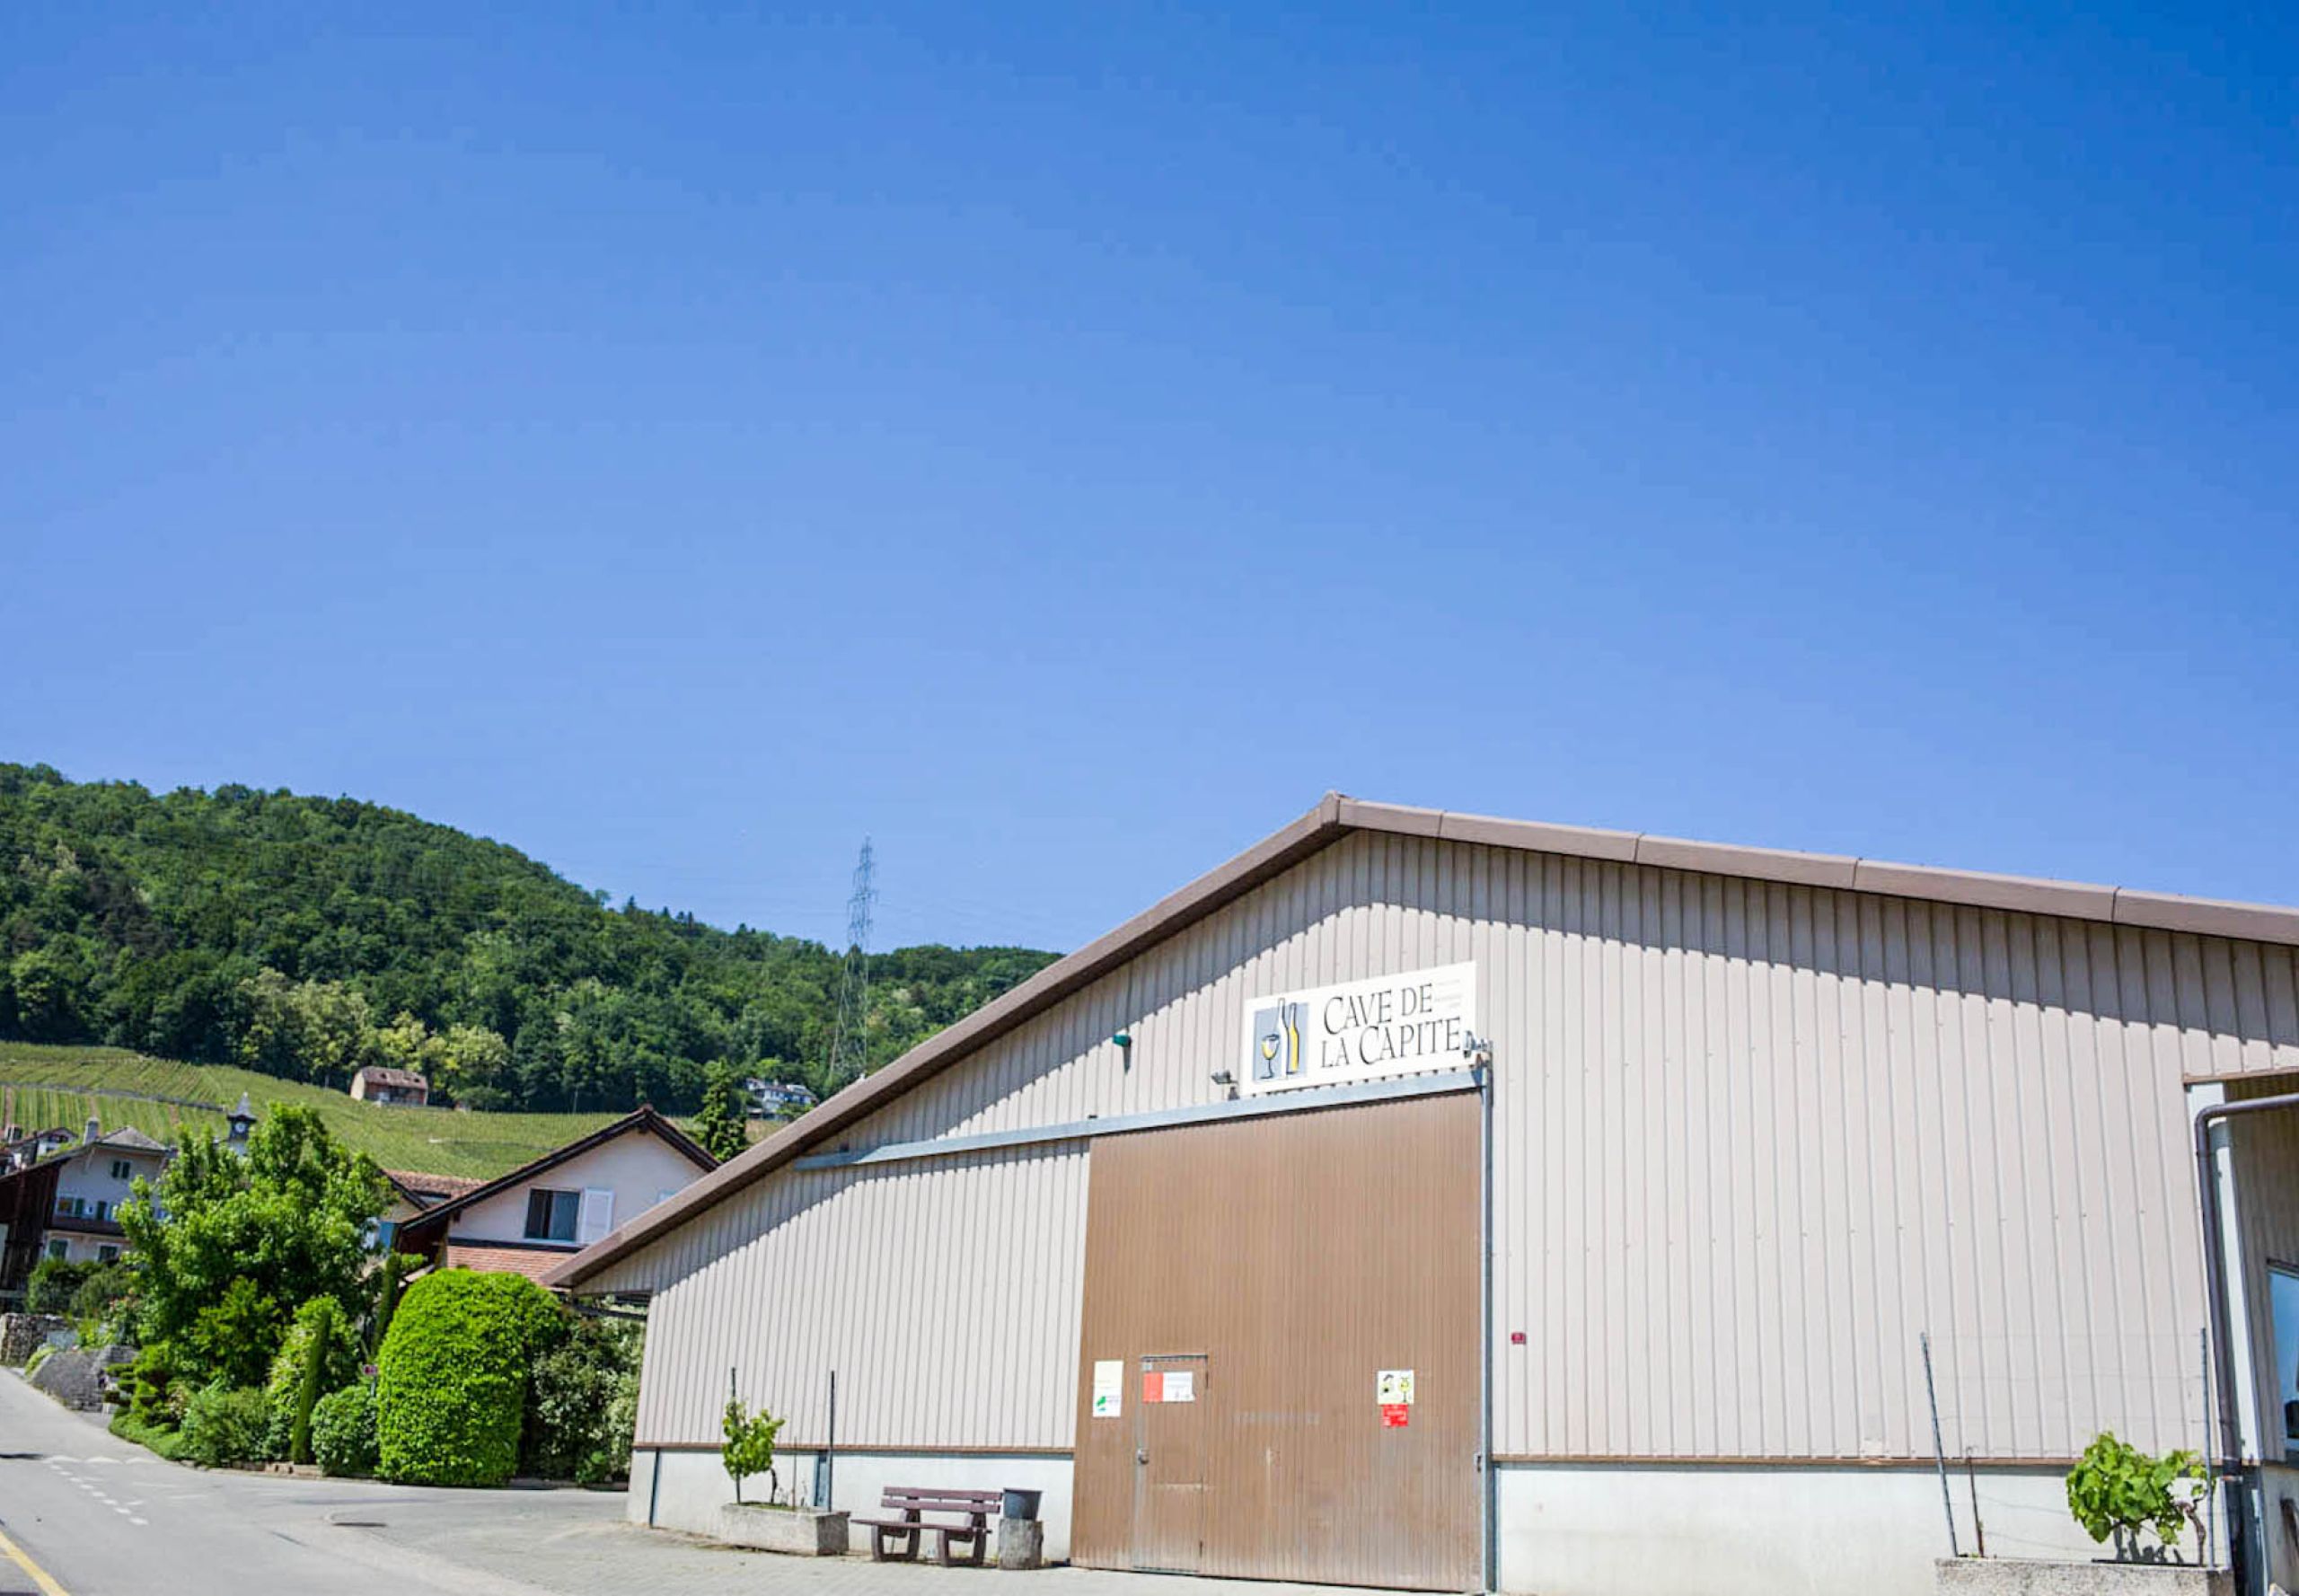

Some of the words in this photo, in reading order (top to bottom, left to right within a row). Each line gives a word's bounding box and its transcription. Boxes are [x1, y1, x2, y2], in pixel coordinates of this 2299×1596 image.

[1324, 989, 1392, 1035] CAVE
[1401, 983, 1432, 1016] DE
[1321, 1037, 1350, 1068] LA
[1360, 1016, 1460, 1064] CAPITE
